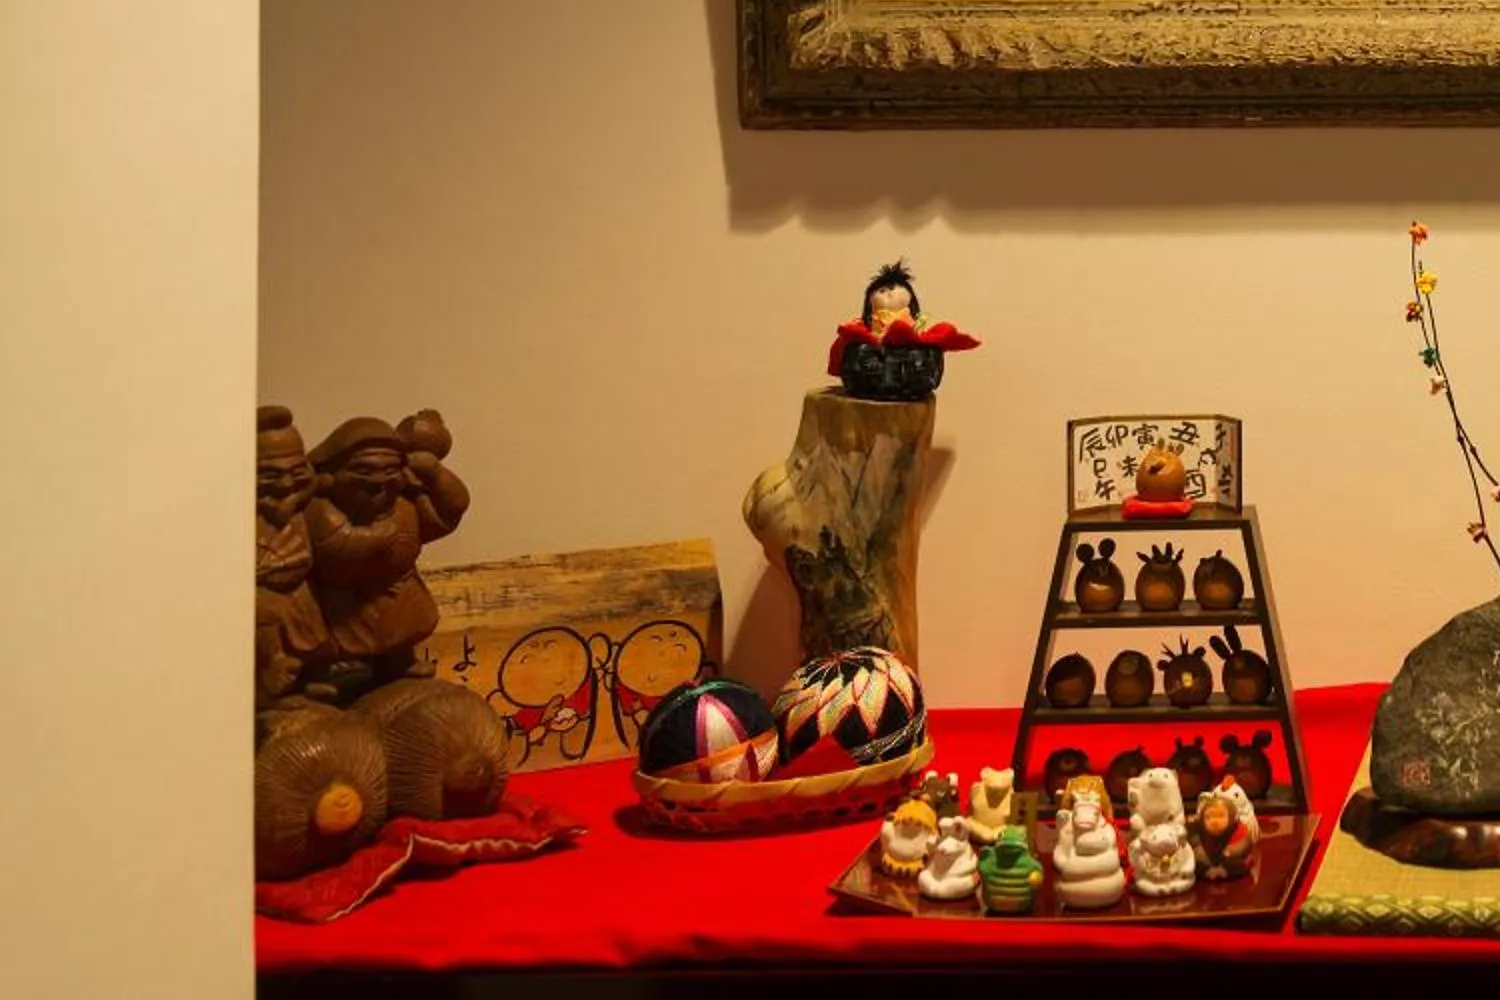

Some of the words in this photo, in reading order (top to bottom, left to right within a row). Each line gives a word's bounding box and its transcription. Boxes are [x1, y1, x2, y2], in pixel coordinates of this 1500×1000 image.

[1078, 426, 1107, 464] 辰
[1105, 424, 1129, 449] 卯
[1131, 423, 1159, 450] 寅
[1168, 421, 1200, 446] 丑
